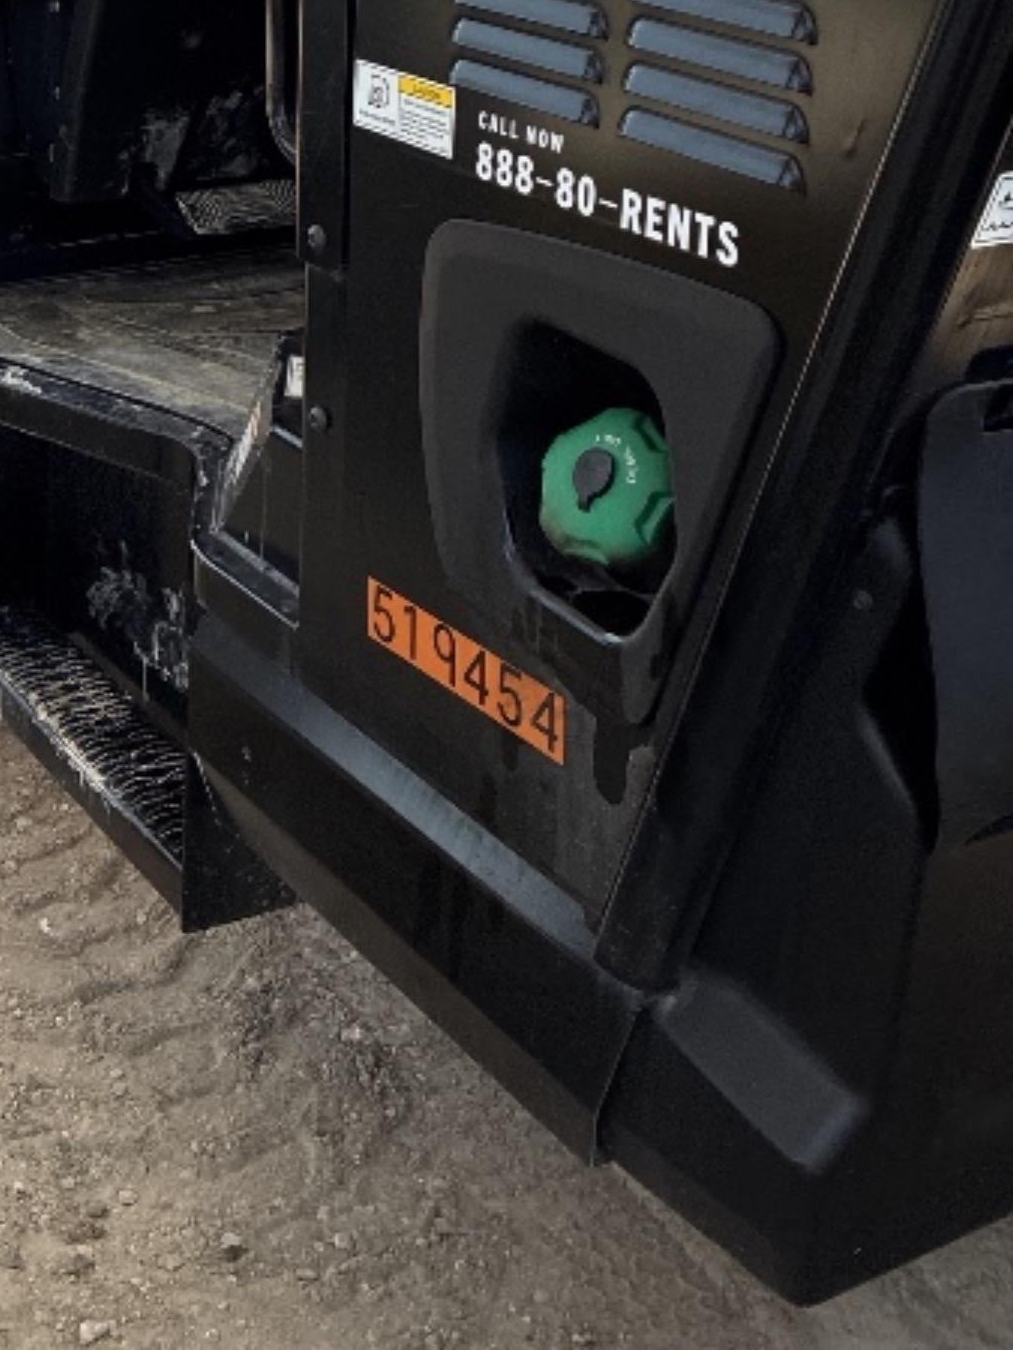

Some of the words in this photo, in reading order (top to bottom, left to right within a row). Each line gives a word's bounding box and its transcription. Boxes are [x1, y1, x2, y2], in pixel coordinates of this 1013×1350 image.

[477, 110, 520, 140] CALL
[525, 124, 565, 154] NOW
[475, 140, 740, 268] 888-80-RENTS
[373, 584, 558, 754] 519454
